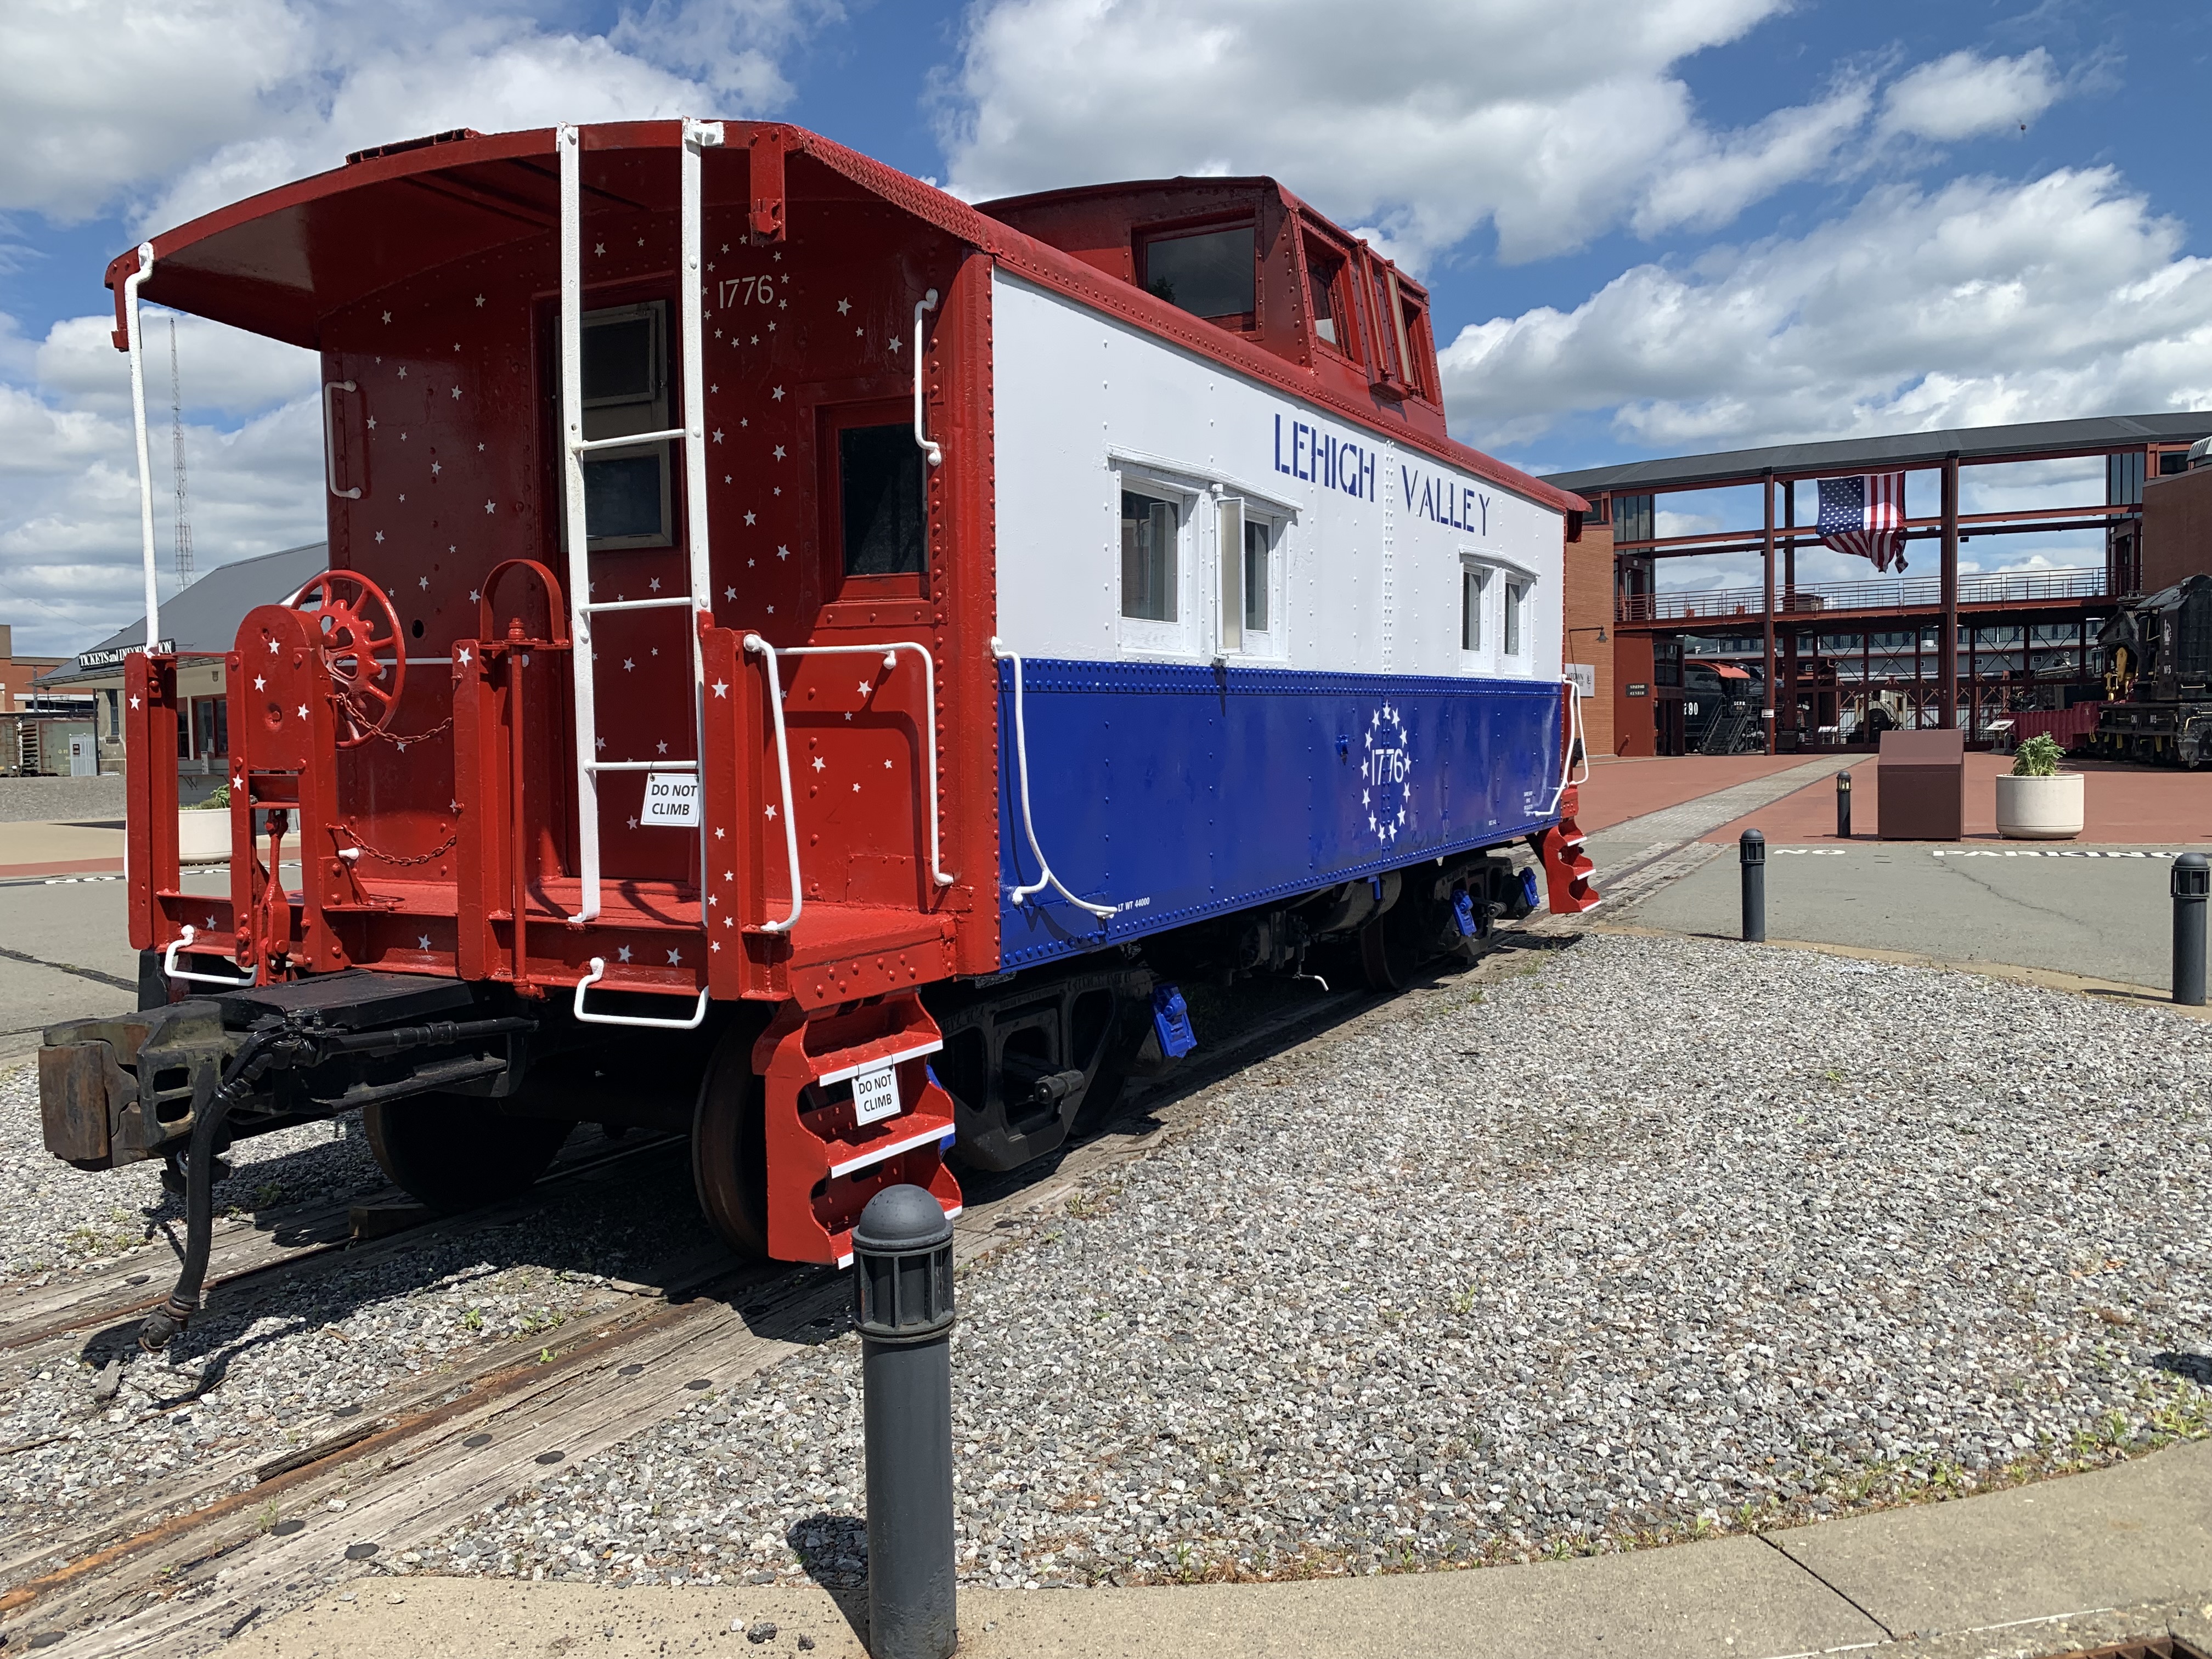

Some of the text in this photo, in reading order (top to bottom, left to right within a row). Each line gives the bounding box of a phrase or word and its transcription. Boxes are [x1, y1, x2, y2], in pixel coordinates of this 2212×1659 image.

[719, 275, 774, 309] 1776
[1275, 413, 1490, 536] LEHIGH VALLEY
[79, 651, 109, 666] TICKETS
[109, 650, 119, 662] and
[1372, 748, 1403, 786] 1776
[651, 785, 697, 797] DO NOT
[652, 803, 690, 815] CLIMB
[1118, 896, 1150, 912] LT WT 44000
[859, 1074, 891, 1094] DO NOT
[864, 1093, 892, 1112] CLIMB
